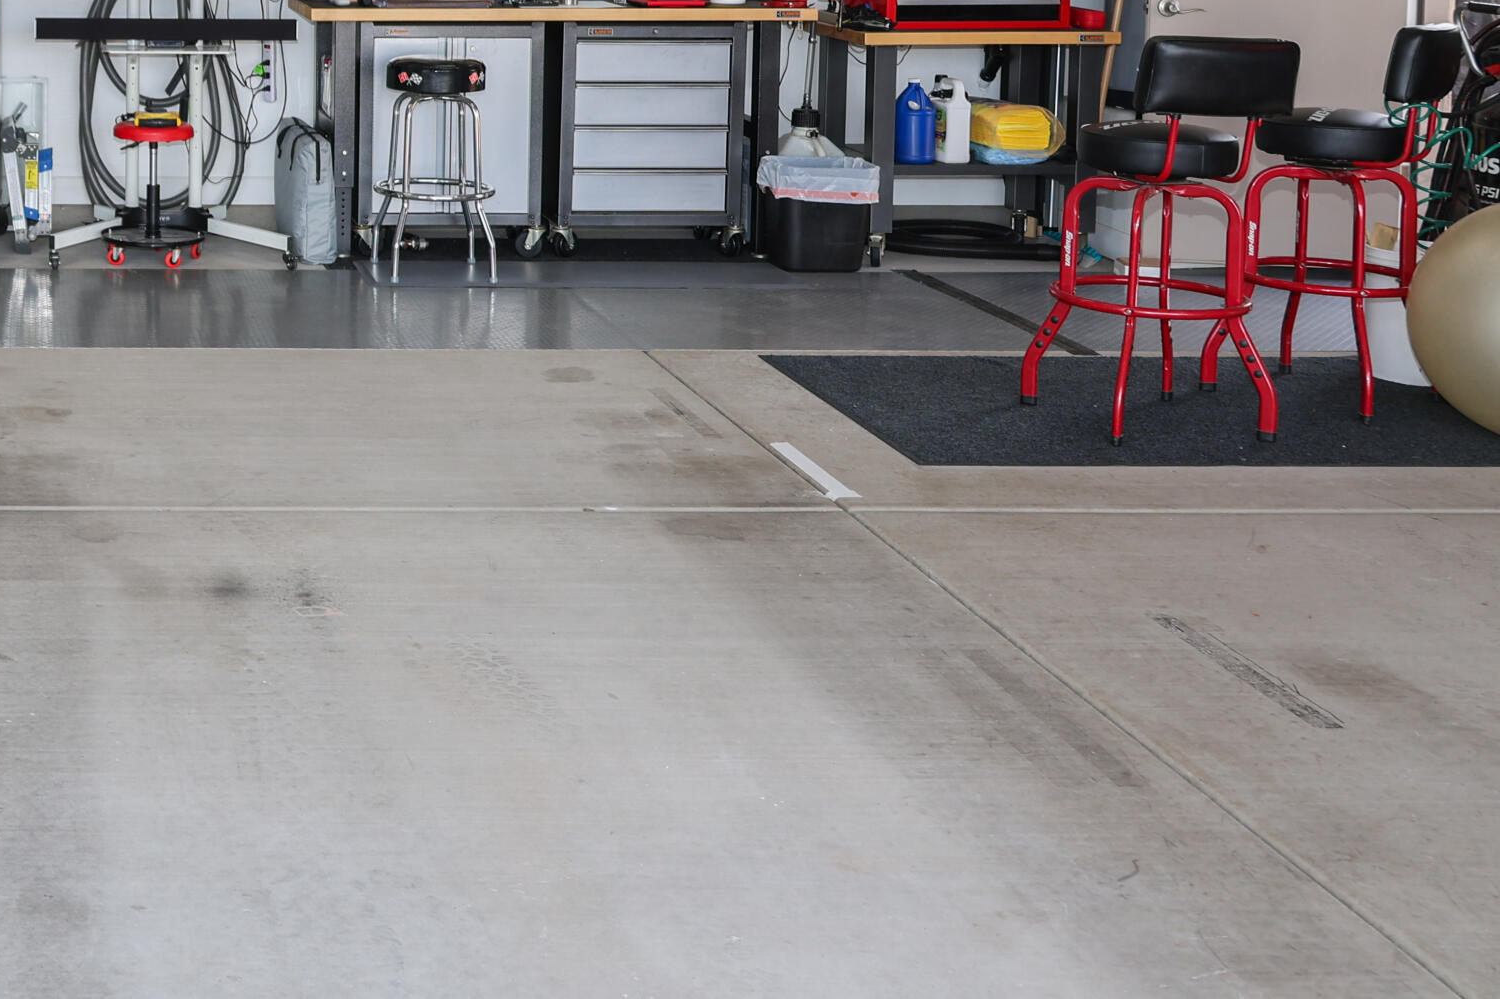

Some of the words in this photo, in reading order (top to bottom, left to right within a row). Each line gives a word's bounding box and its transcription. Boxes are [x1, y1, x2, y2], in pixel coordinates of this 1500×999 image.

[1481, 186, 1500, 199] PSI
[1065, 230, 1073, 267] Snap-on
[1249, 221, 1257, 256] Snap-on
